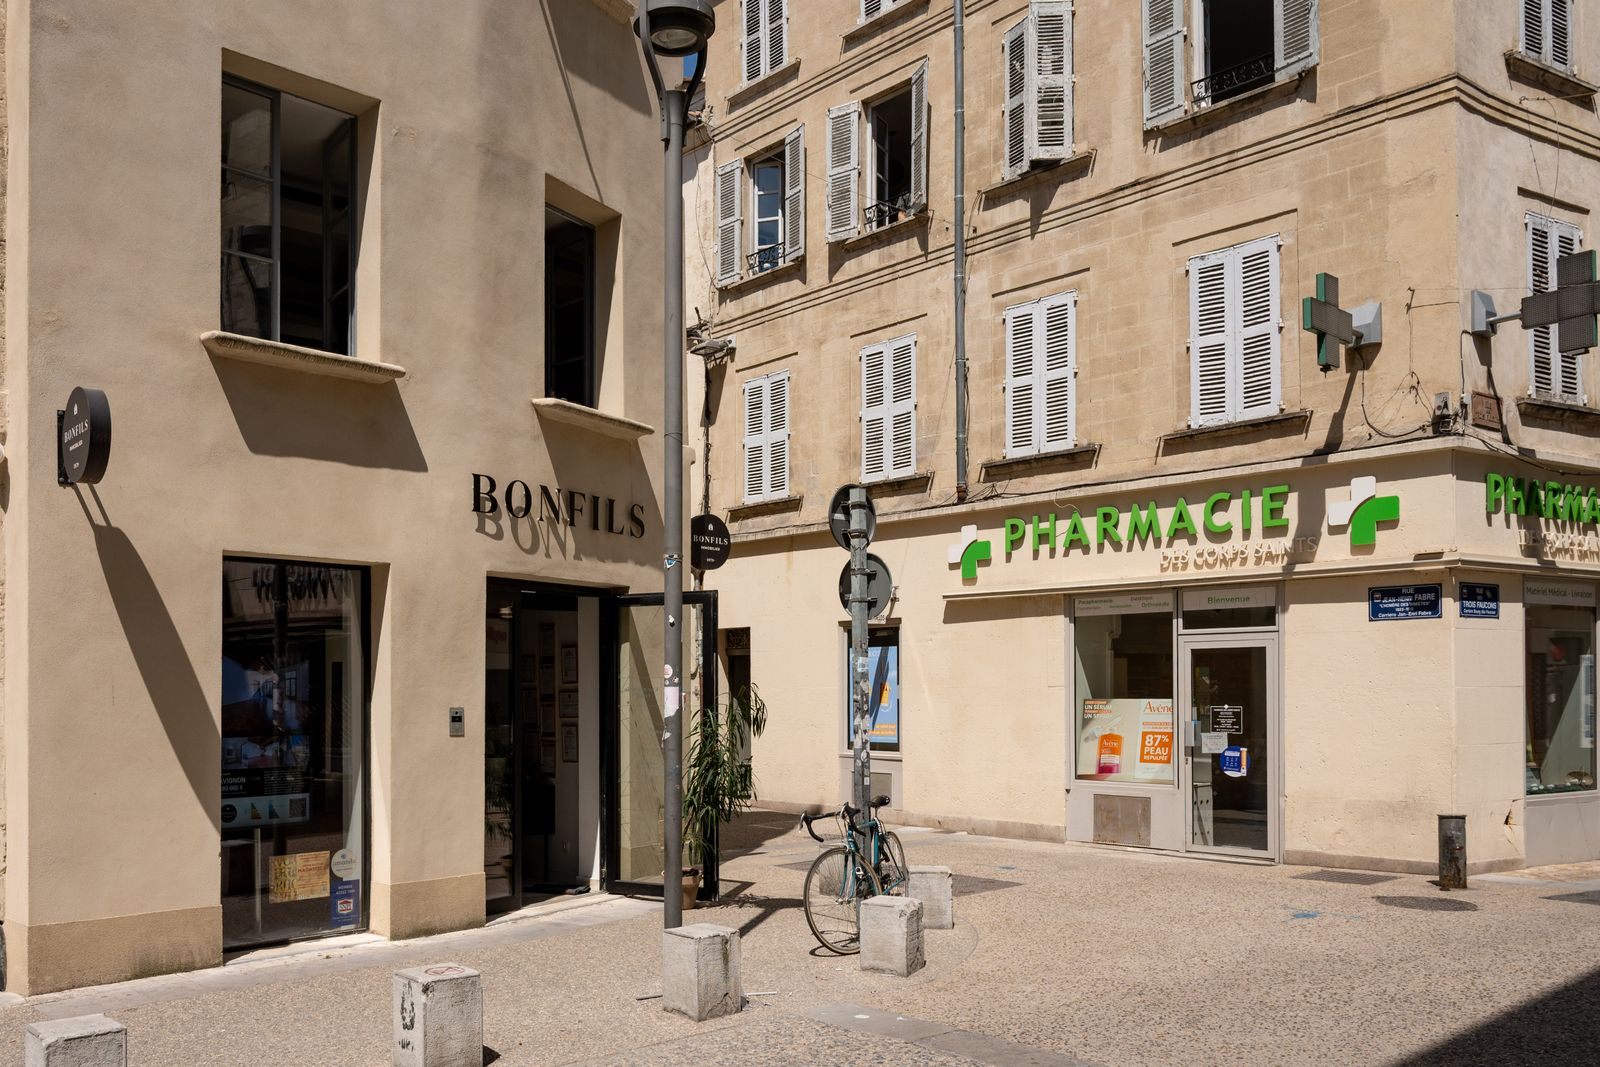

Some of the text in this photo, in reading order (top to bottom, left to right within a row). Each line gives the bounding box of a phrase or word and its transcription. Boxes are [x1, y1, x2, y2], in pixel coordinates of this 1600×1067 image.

[64, 419, 89, 443] BONFILS
[471, 473, 645, 538] BONFILS
[1004, 485, 1290, 553] PHARMACIE
[693, 534, 729, 546] BONFILS
[1160, 536, 1318, 564] DES CORPS SAINTS
[1207, 596, 1251, 604] Bienvenue
[1414, 592, 1436, 601] FABRE
[1462, 600, 1497, 609] TROIS FAUCONS
[1143, 701, 1173, 713] Avène
[1145, 734, 1169, 747] 87%
[1144, 746, 1168, 755] PEAU
